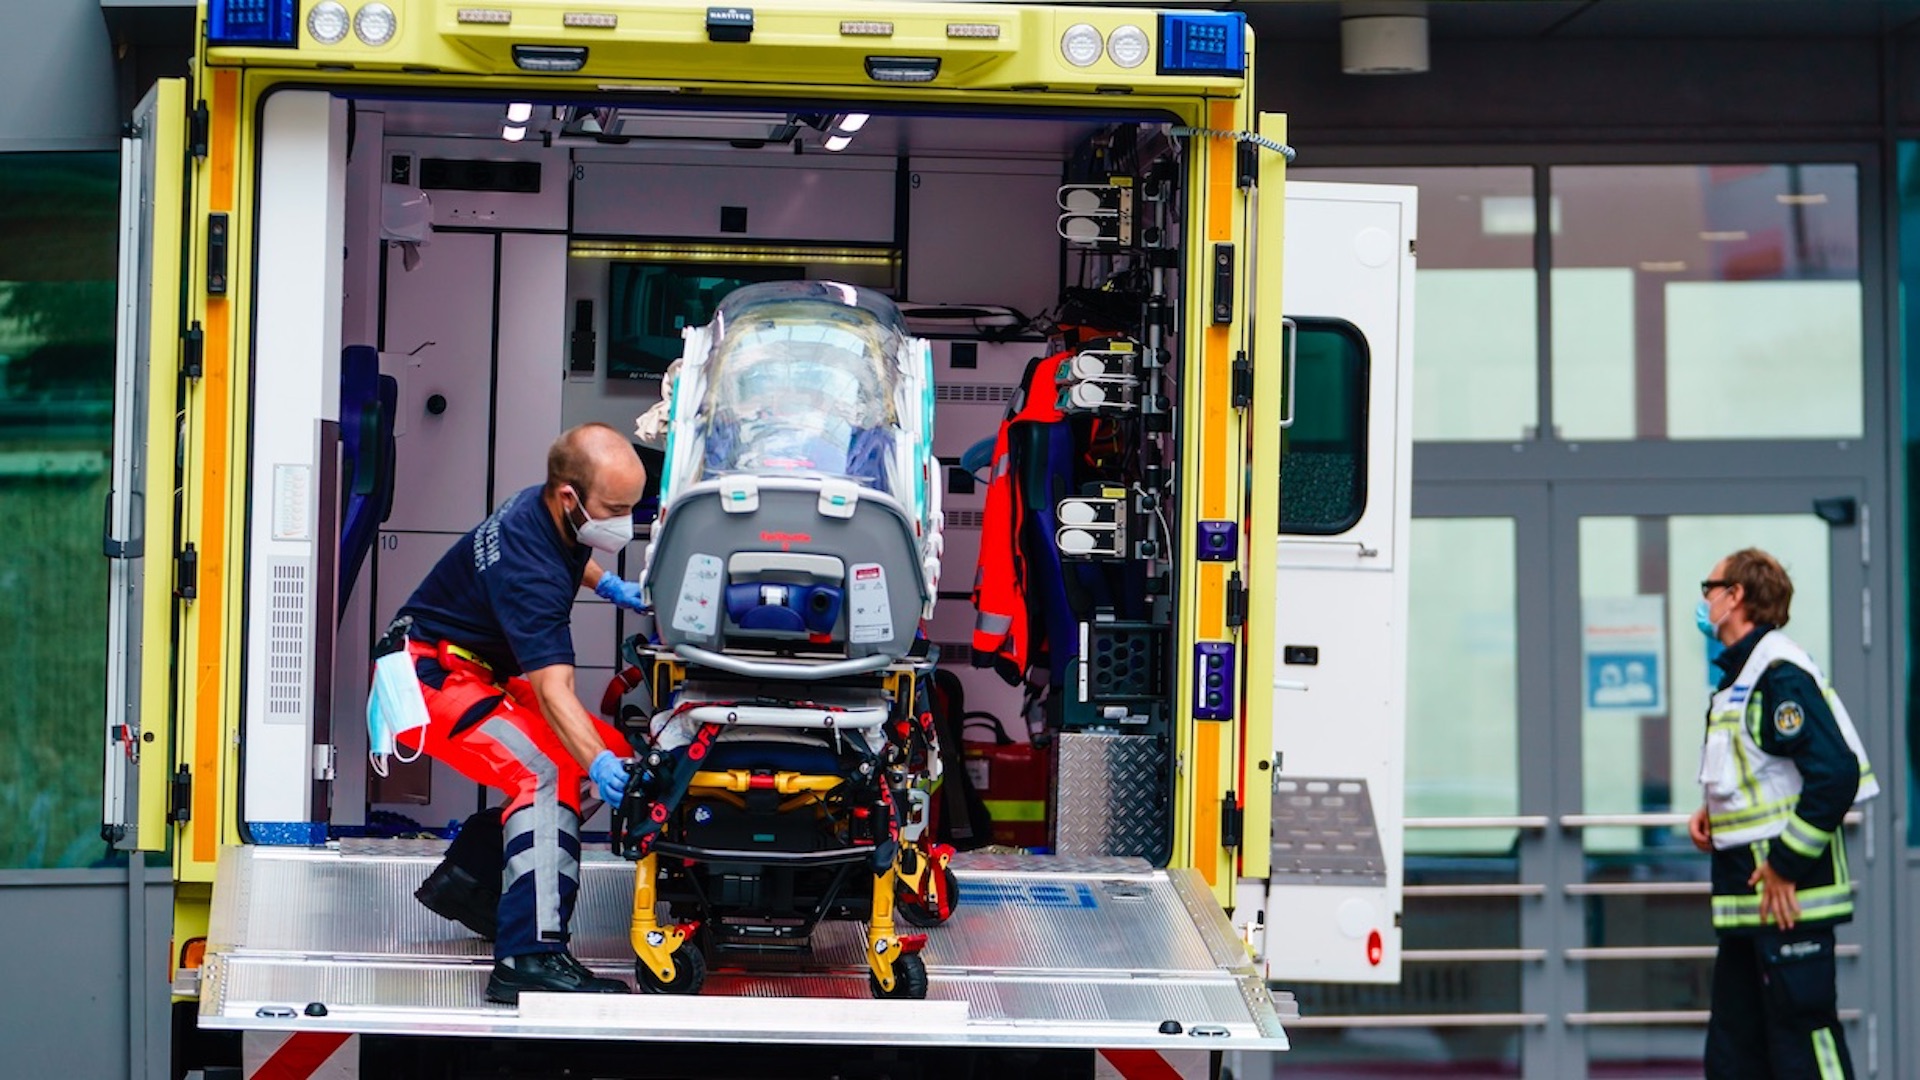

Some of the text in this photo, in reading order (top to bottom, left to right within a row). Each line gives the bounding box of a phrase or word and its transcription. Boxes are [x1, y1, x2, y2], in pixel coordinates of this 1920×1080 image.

[576, 164, 584, 181] 8
[911, 173, 921, 189] 9
[381, 534, 398, 551] 10
